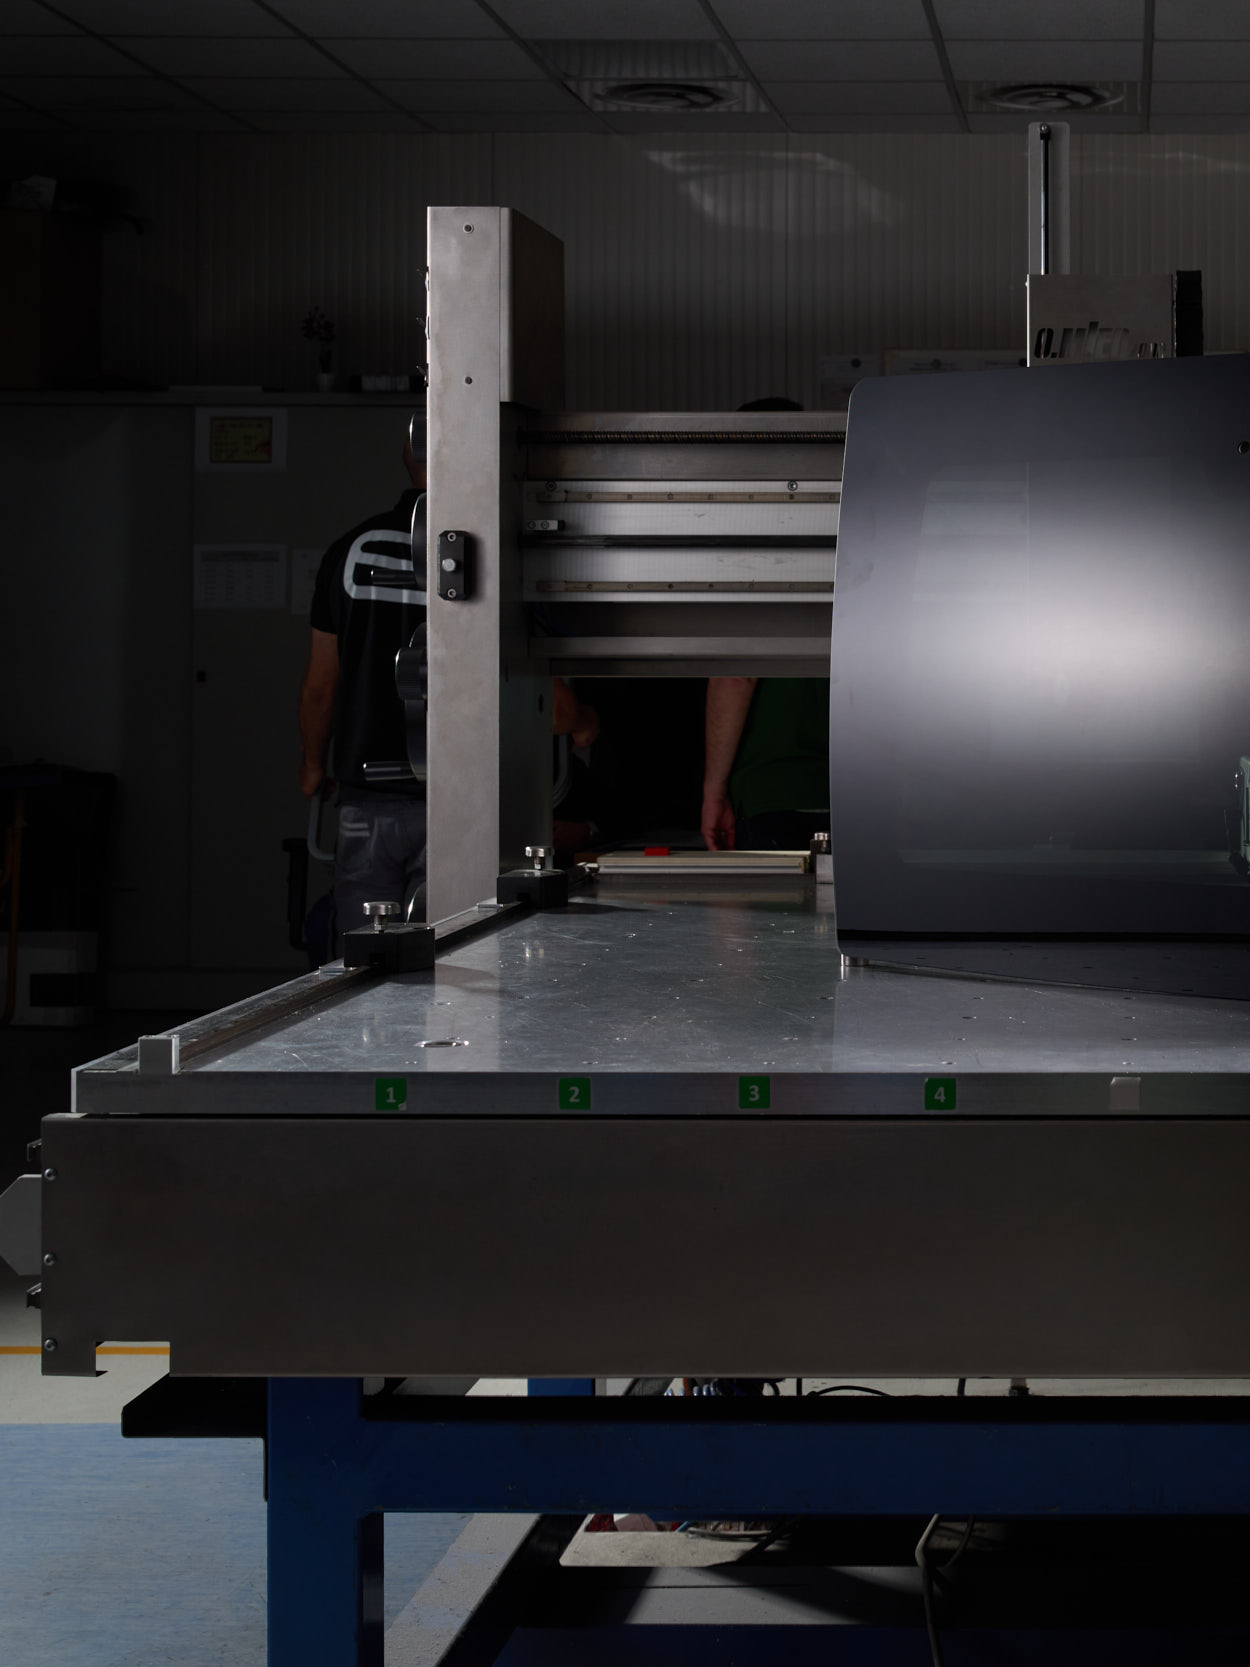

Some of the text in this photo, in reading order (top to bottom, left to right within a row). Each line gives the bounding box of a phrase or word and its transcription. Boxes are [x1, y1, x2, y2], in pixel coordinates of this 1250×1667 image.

[386, 1087, 397, 1103] 1
[568, 1086, 580, 1103] 2
[748, 1084, 760, 1102] 3
[933, 1086, 946, 1103] 4
